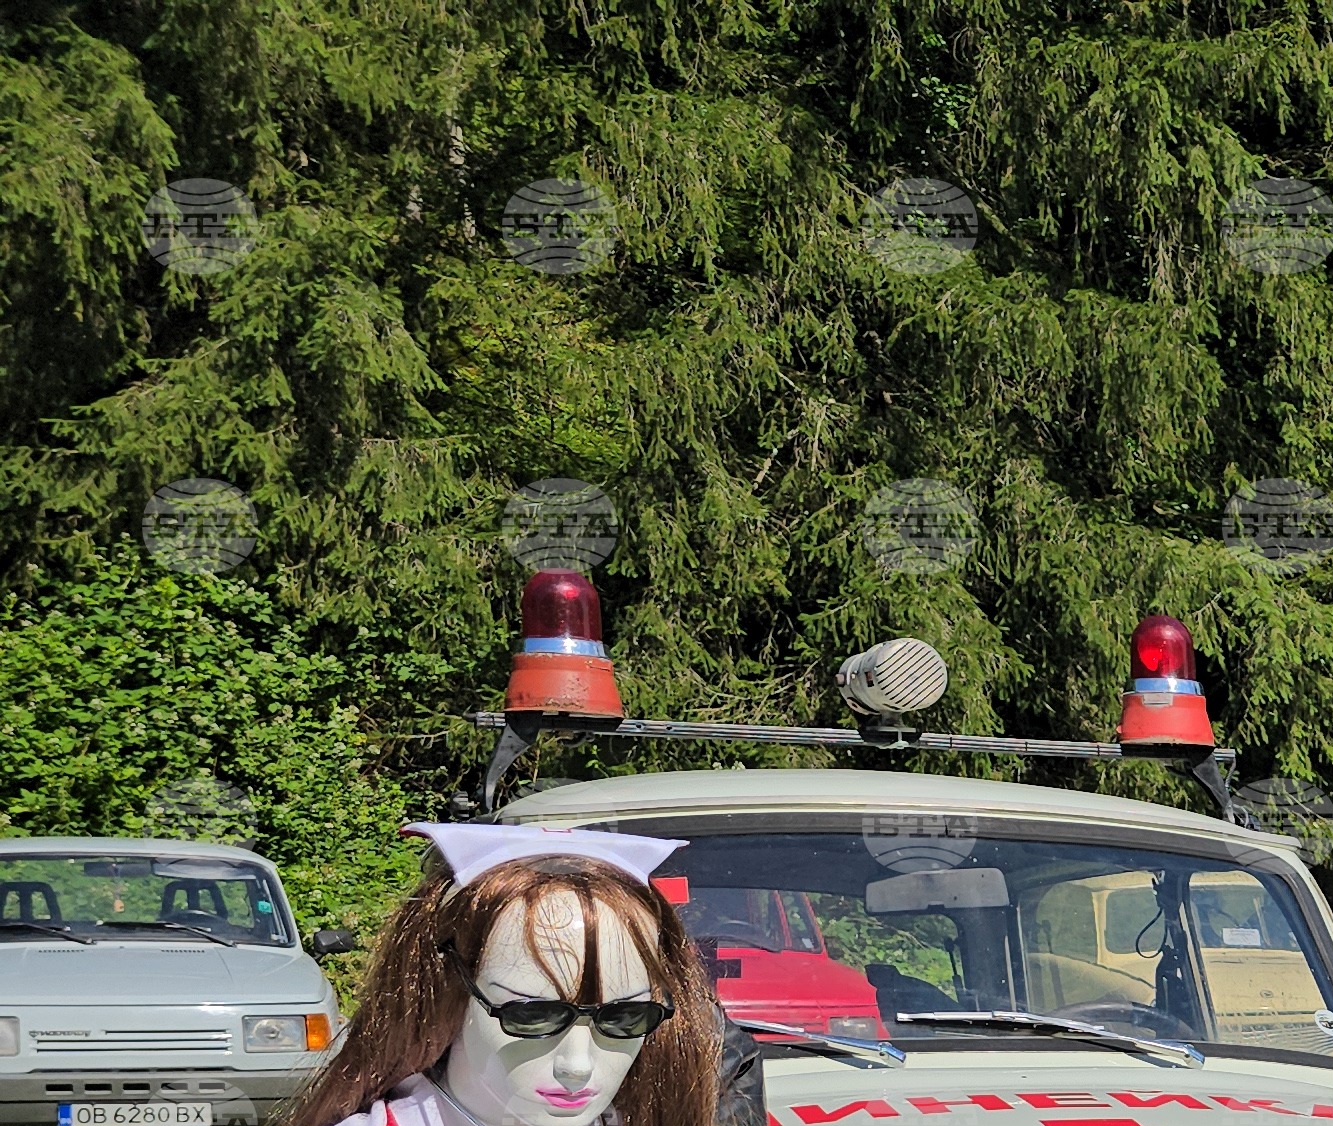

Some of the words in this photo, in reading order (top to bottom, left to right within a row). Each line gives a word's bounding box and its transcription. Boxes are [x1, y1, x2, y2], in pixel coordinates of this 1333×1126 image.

[77, 1107, 107, 1123] OB
[114, 1106, 170, 1123] 6280
[176, 1106, 206, 1123] BX
